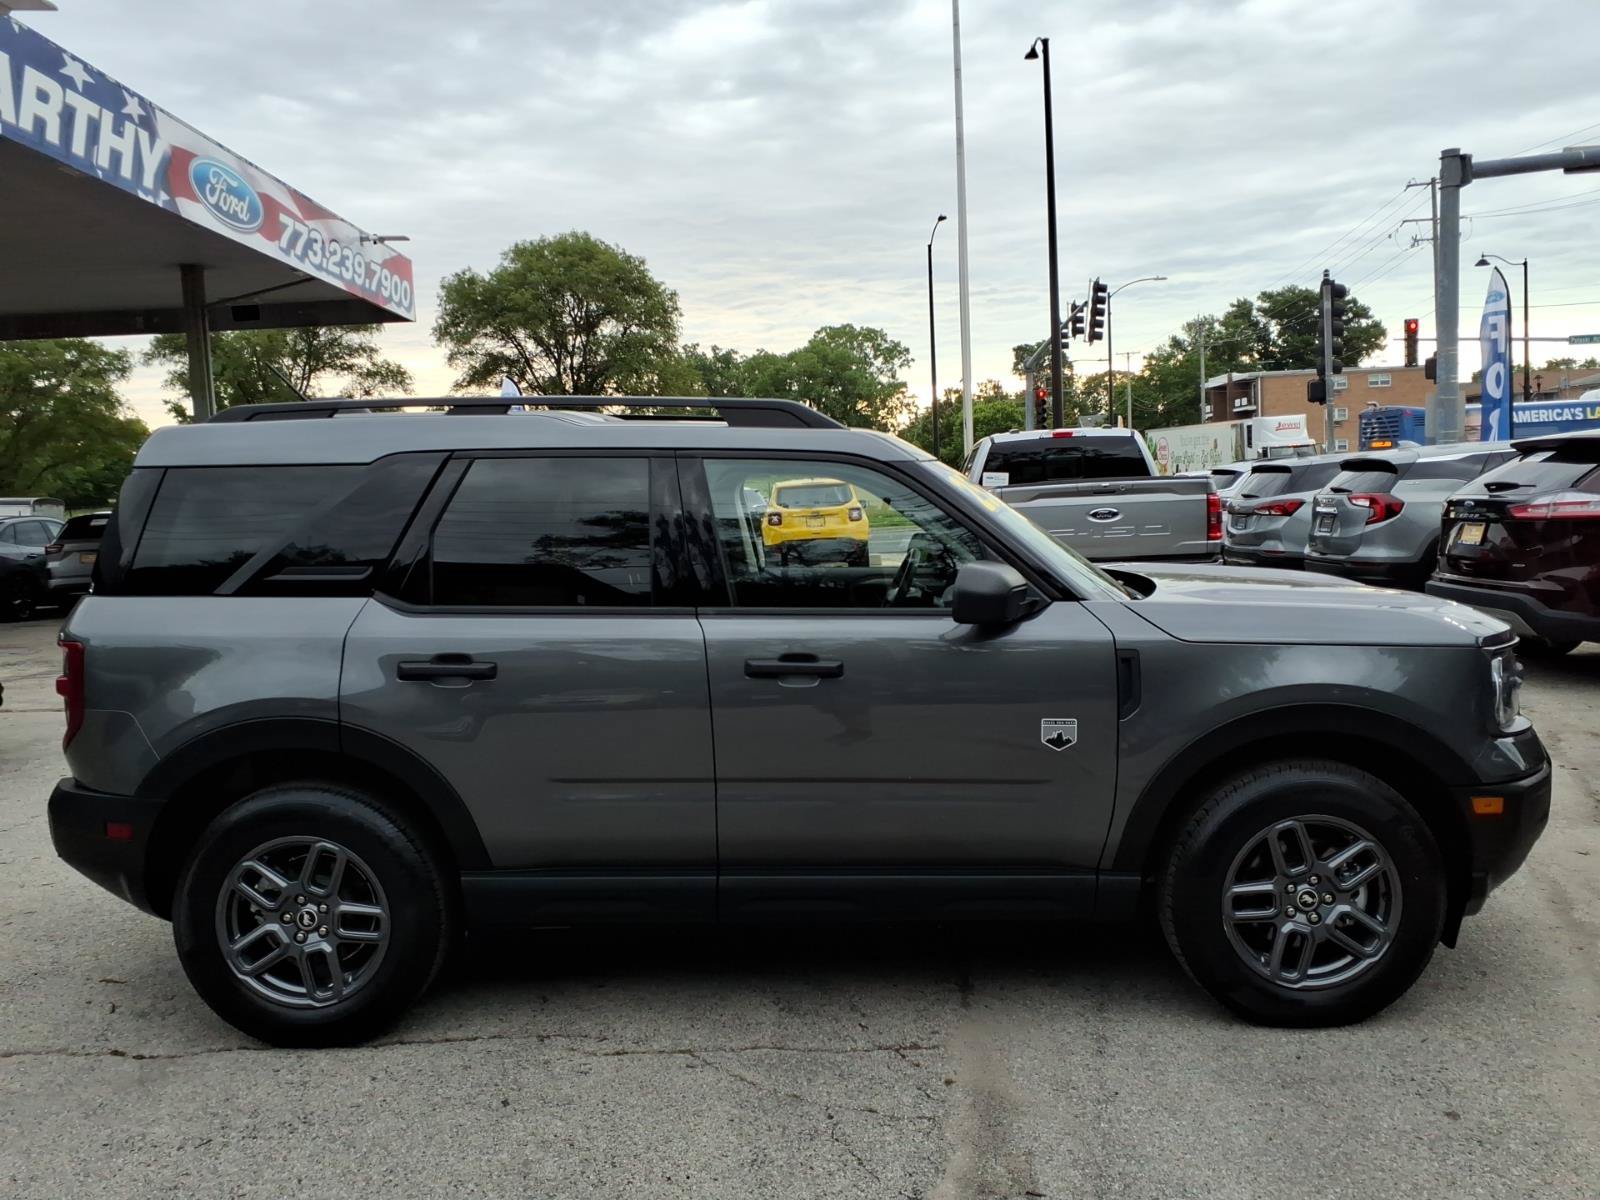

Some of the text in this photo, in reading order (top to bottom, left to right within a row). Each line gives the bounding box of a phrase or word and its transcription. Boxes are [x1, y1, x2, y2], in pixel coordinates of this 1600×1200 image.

[205, 167, 251, 222] Ford
[277, 212, 412, 309] 773.239.7900
[1513, 407, 1583, 423] AMERICA'S
